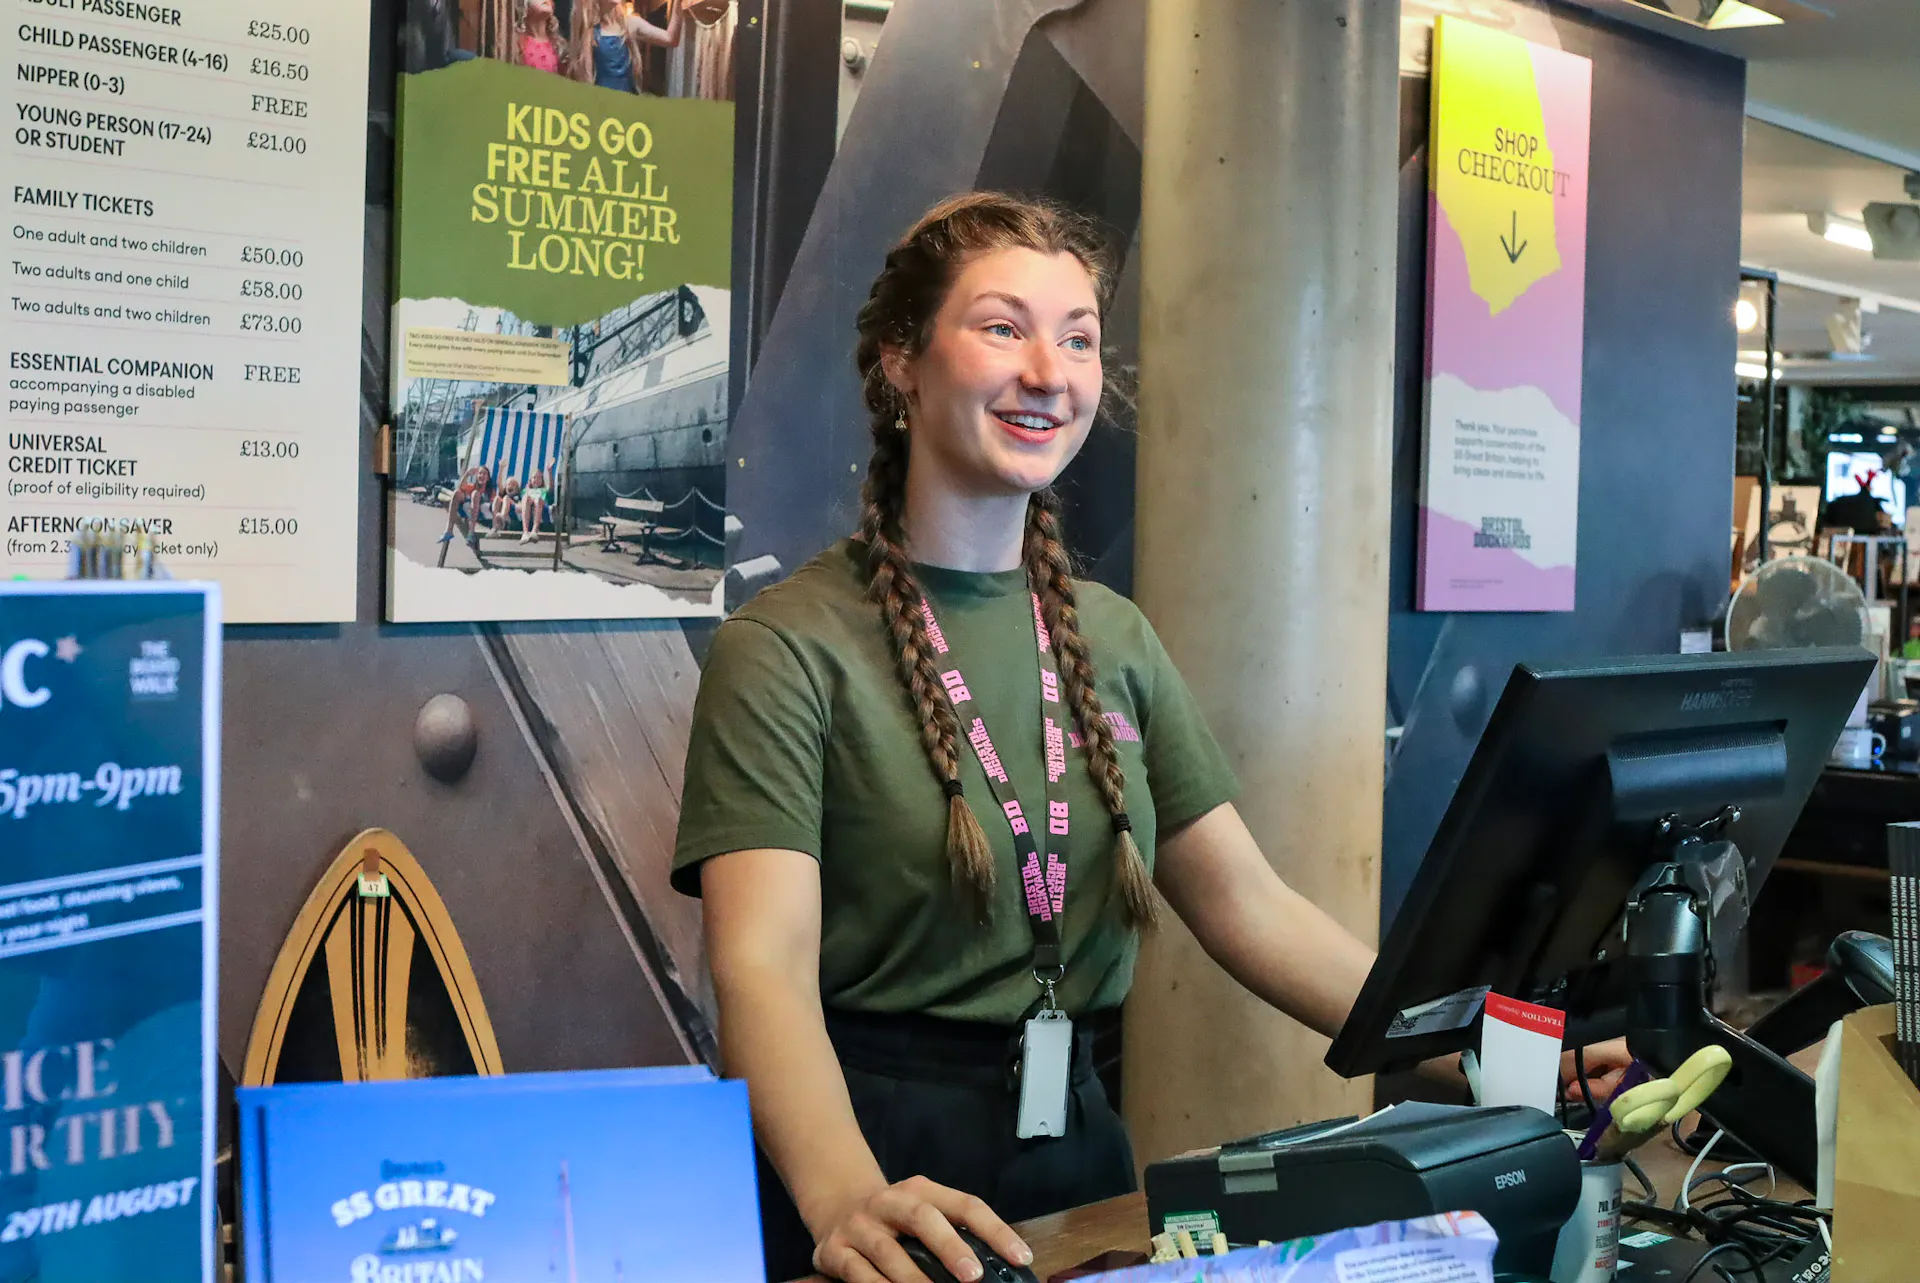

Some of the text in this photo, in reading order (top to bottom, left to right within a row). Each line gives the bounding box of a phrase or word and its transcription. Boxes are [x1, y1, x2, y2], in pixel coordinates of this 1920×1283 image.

[82, 0, 181, 26] PASSENGER
[248, 20, 310, 45] £25.00
[18, 25, 229, 72] CHILD PASSENGER (4-16)
[17, 64, 125, 94] NIPPER (0-3)
[250, 58, 309, 81] £16.50
[251, 95, 308, 118] FREE
[16, 104, 212, 145] YOUNG PERSON (17-24)
[507, 102, 653, 159] KIDS GO
[15, 128, 125, 156] OR STUDENT
[247, 132, 306, 154] £21.00
[1495, 127, 1538, 160] SHOP
[487, 142, 668, 203] FREE ALL
[1458, 148, 1570, 197] CHECKOUT
[14, 186, 154, 216] FAMILY TICKETS
[471, 183, 680, 245] SUMMER
[13, 226, 207, 256] One adult and two children
[241, 246, 304, 268] £50.00
[507, 230, 645, 282] LONG!
[12, 261, 189, 289] Two adults and one child
[240, 280, 303, 301] £58.00
[12, 298, 211, 326] Two adults and two children
[240, 313, 302, 334] £73.00
[10, 352, 214, 380] ESSENTIAL COMPANION
[244, 364, 301, 384] FREE
[9, 379, 195, 399] accompanying a disabled
[9, 399, 139, 418] paying passenger
[9, 433, 107, 454] UNIVERSAL
[240, 440, 299, 458] £13.00
[8, 456, 138, 477] CREDIT TICKET
[7, 479, 206, 501] (proof of eligibility required)
[7, 516, 173, 535] AFTERNOON SAVER
[239, 518, 298, 536] £15.00
[1481, 516, 1525, 534] BRISTOL
[7, 538, 46, 556] (from
[153, 542, 182, 555] cket
[186, 540, 218, 558] only)
[1473, 532, 1531, 548] DOCKYARDS
[968, 727, 997, 779] BRISTOL
[972, 717, 1009, 784] DOCKYARDS
[1045, 717, 1058, 783] DOCKYARDS
[1053, 727, 1066, 776] BRISTOL
[1021, 861, 1040, 916] BRISTOL
[1028, 852, 1052, 922] DOCKYARDS
[1892, 917, 1900, 938] GREAT
[1893, 939, 1901, 965] BRITAIN
[1521, 1011, 1563, 1027] TRACTION
[1495, 1169, 1527, 1190] EPSON
[1, 1176, 199, 1243] 29TH AUGUST
[331, 1180, 496, 1229] SS GREAT
